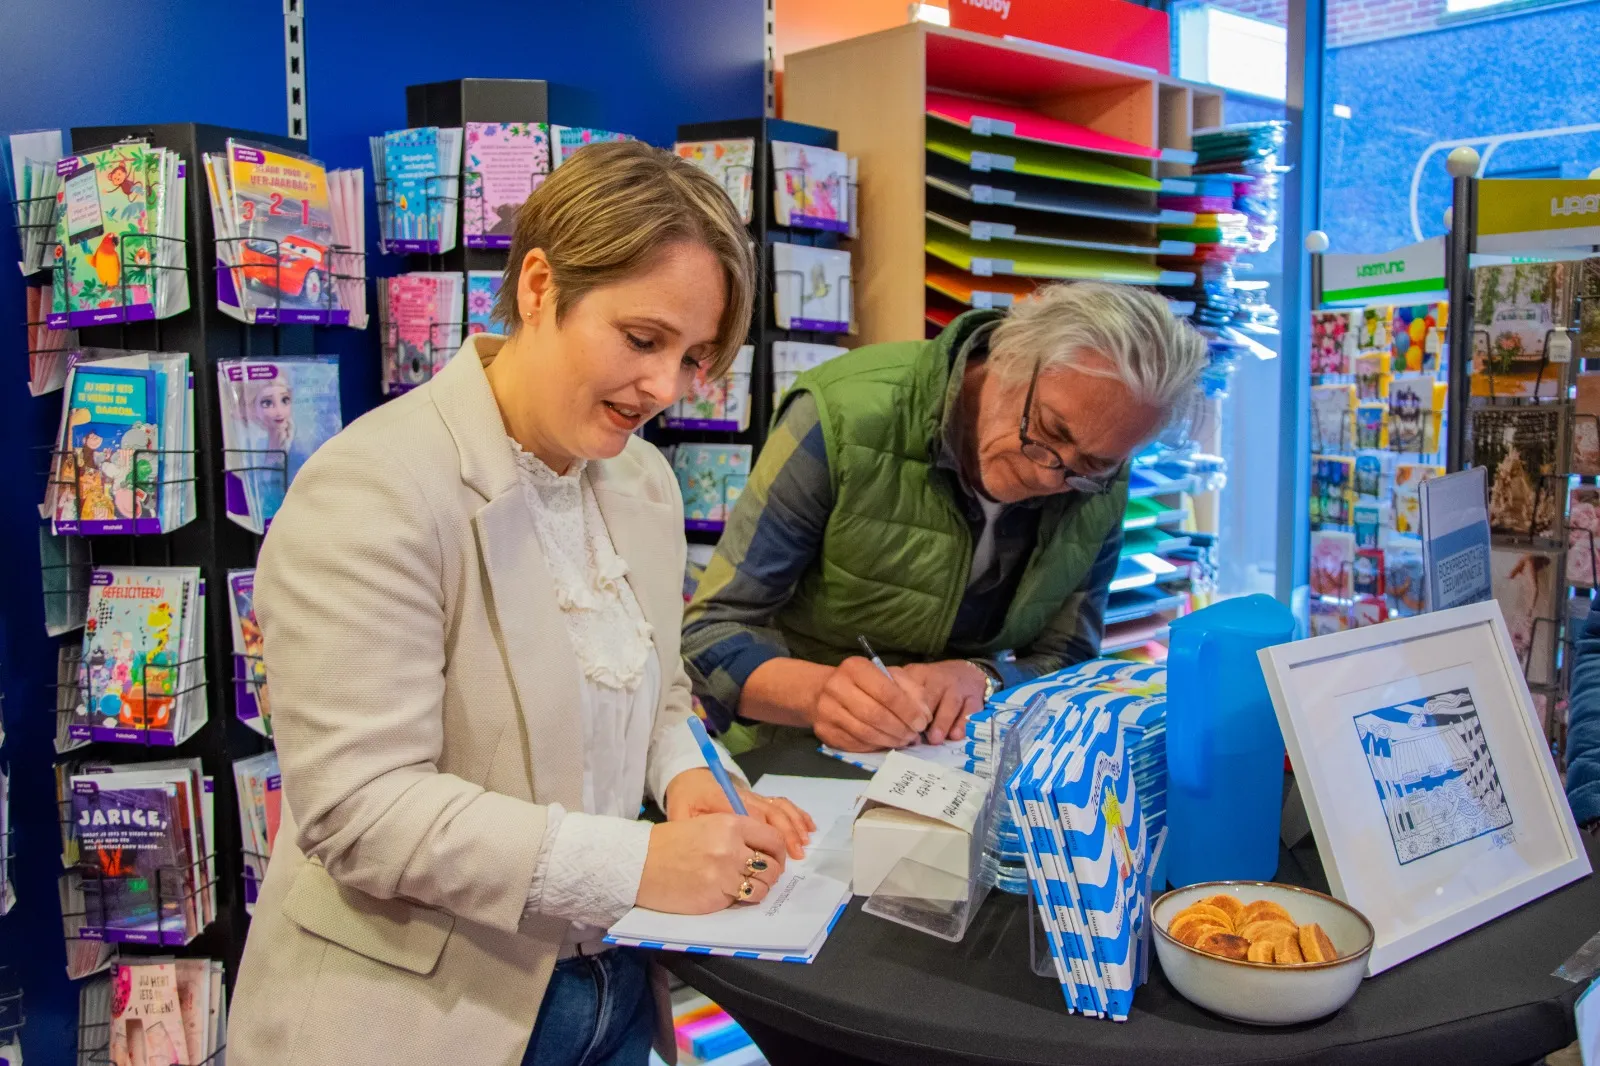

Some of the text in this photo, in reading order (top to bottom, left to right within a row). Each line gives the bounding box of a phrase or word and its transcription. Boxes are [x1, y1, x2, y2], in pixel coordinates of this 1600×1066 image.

[242, 200, 255, 220] 3
[269, 193, 283, 216] 2
[301, 199, 309, 225] 1
[102, 586, 164, 599] GEFELICITEERD!
[78, 809, 168, 830] JARIGE,
[143, 1000, 174, 1015] VIEEN!
